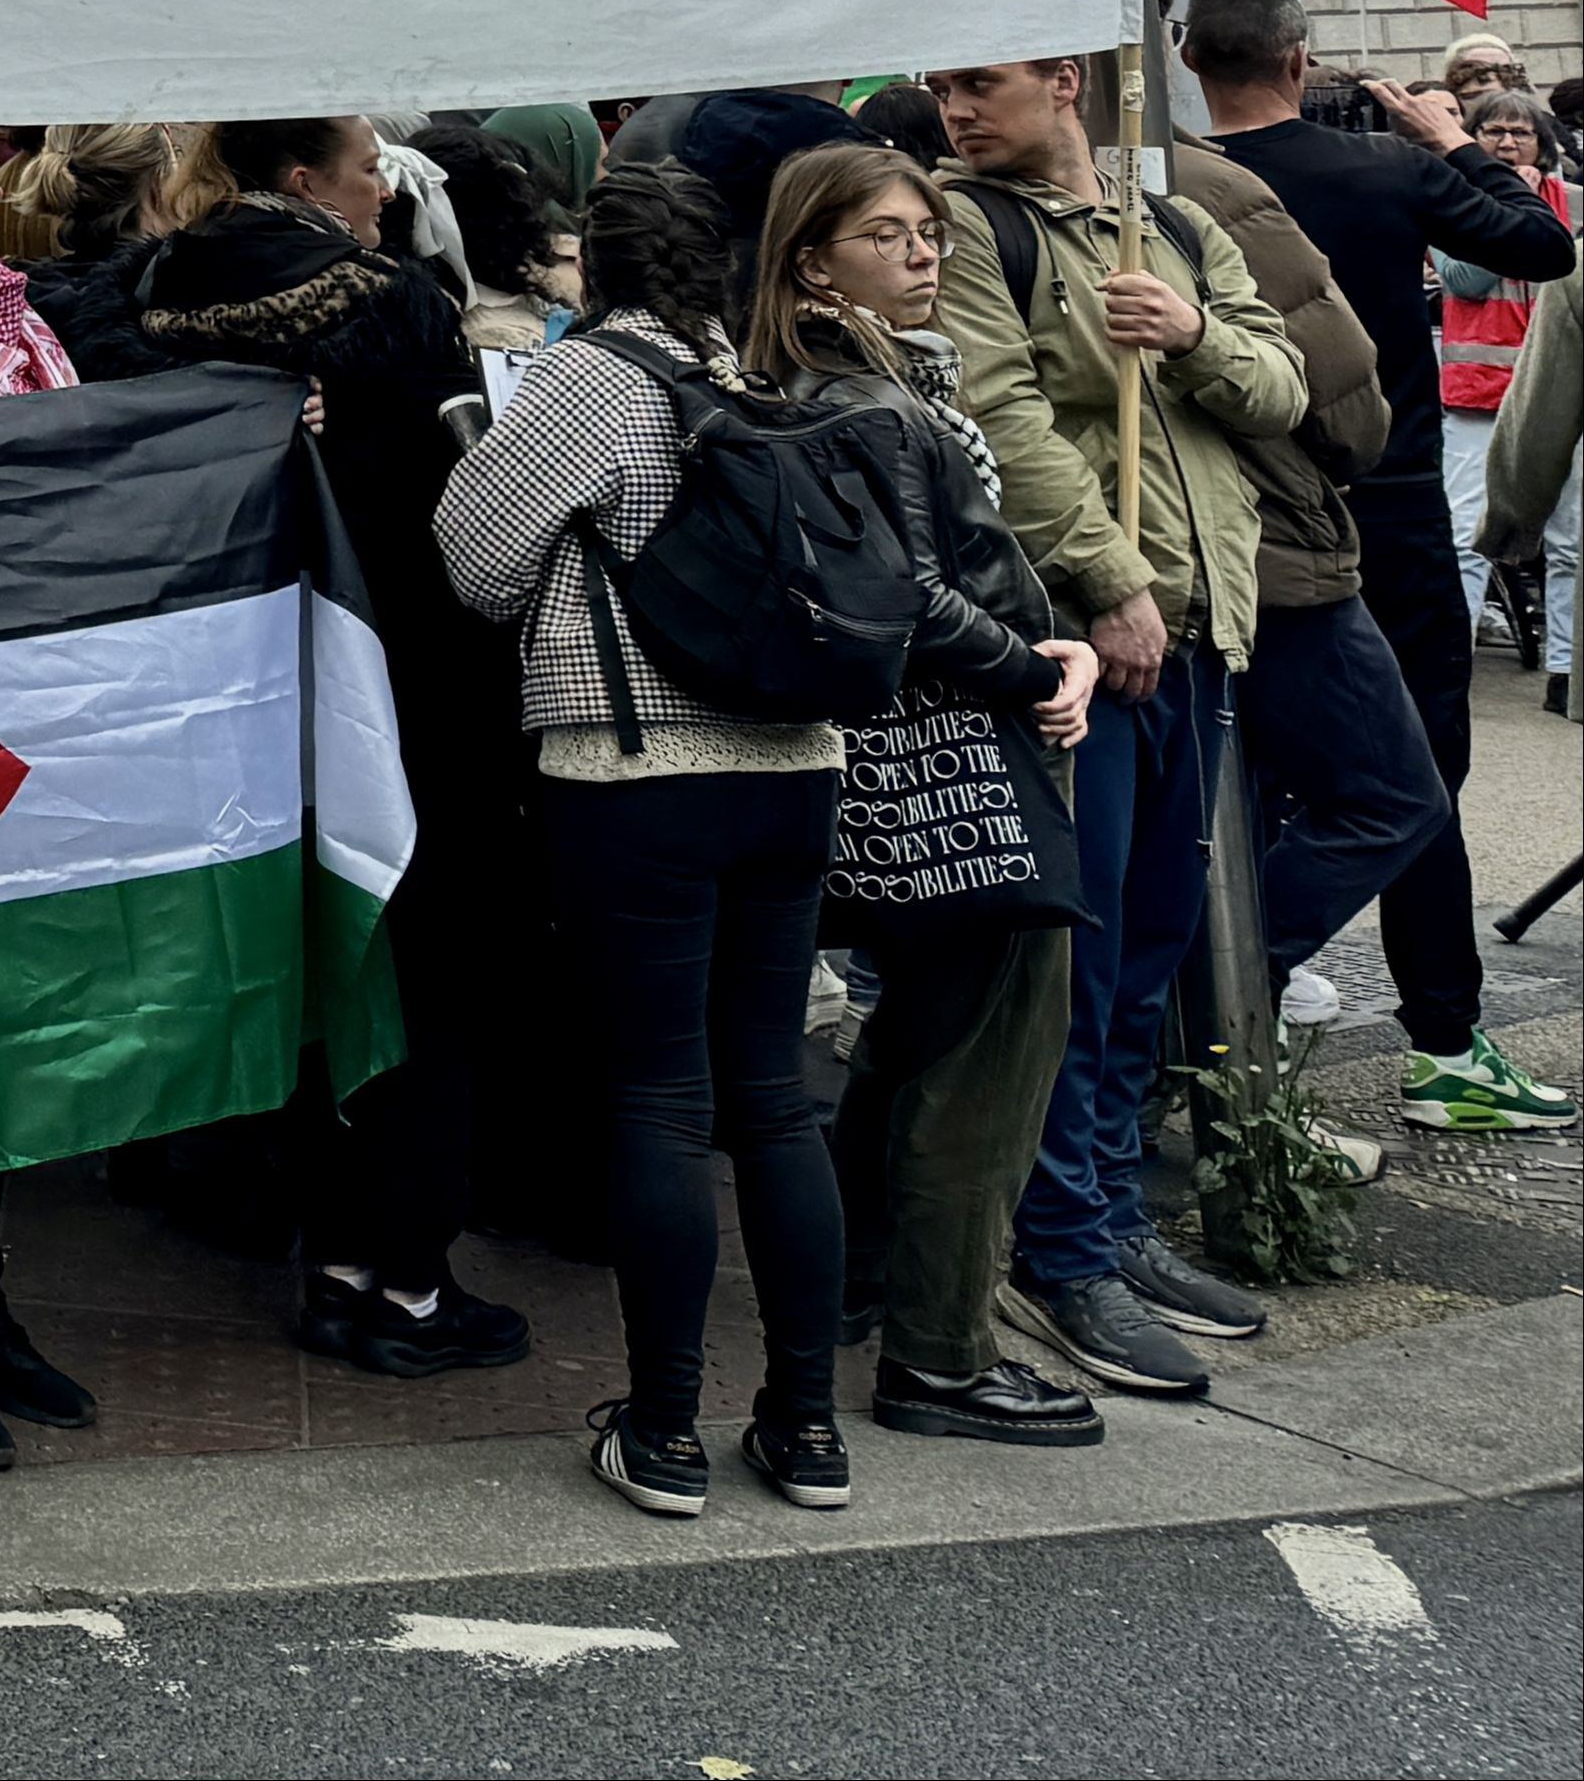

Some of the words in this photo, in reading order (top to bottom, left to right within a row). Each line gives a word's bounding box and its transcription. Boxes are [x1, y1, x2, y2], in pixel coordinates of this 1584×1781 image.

[852, 758, 918, 792] OPEN
[921, 749, 961, 783] TO
[960, 743, 1007, 774] THE
[864, 829, 932, 865] OPEN
[932, 820, 979, 855] TO
[979, 814, 1029, 846] THE
[826, 851, 1041, 903] OSSIBILITIES!
